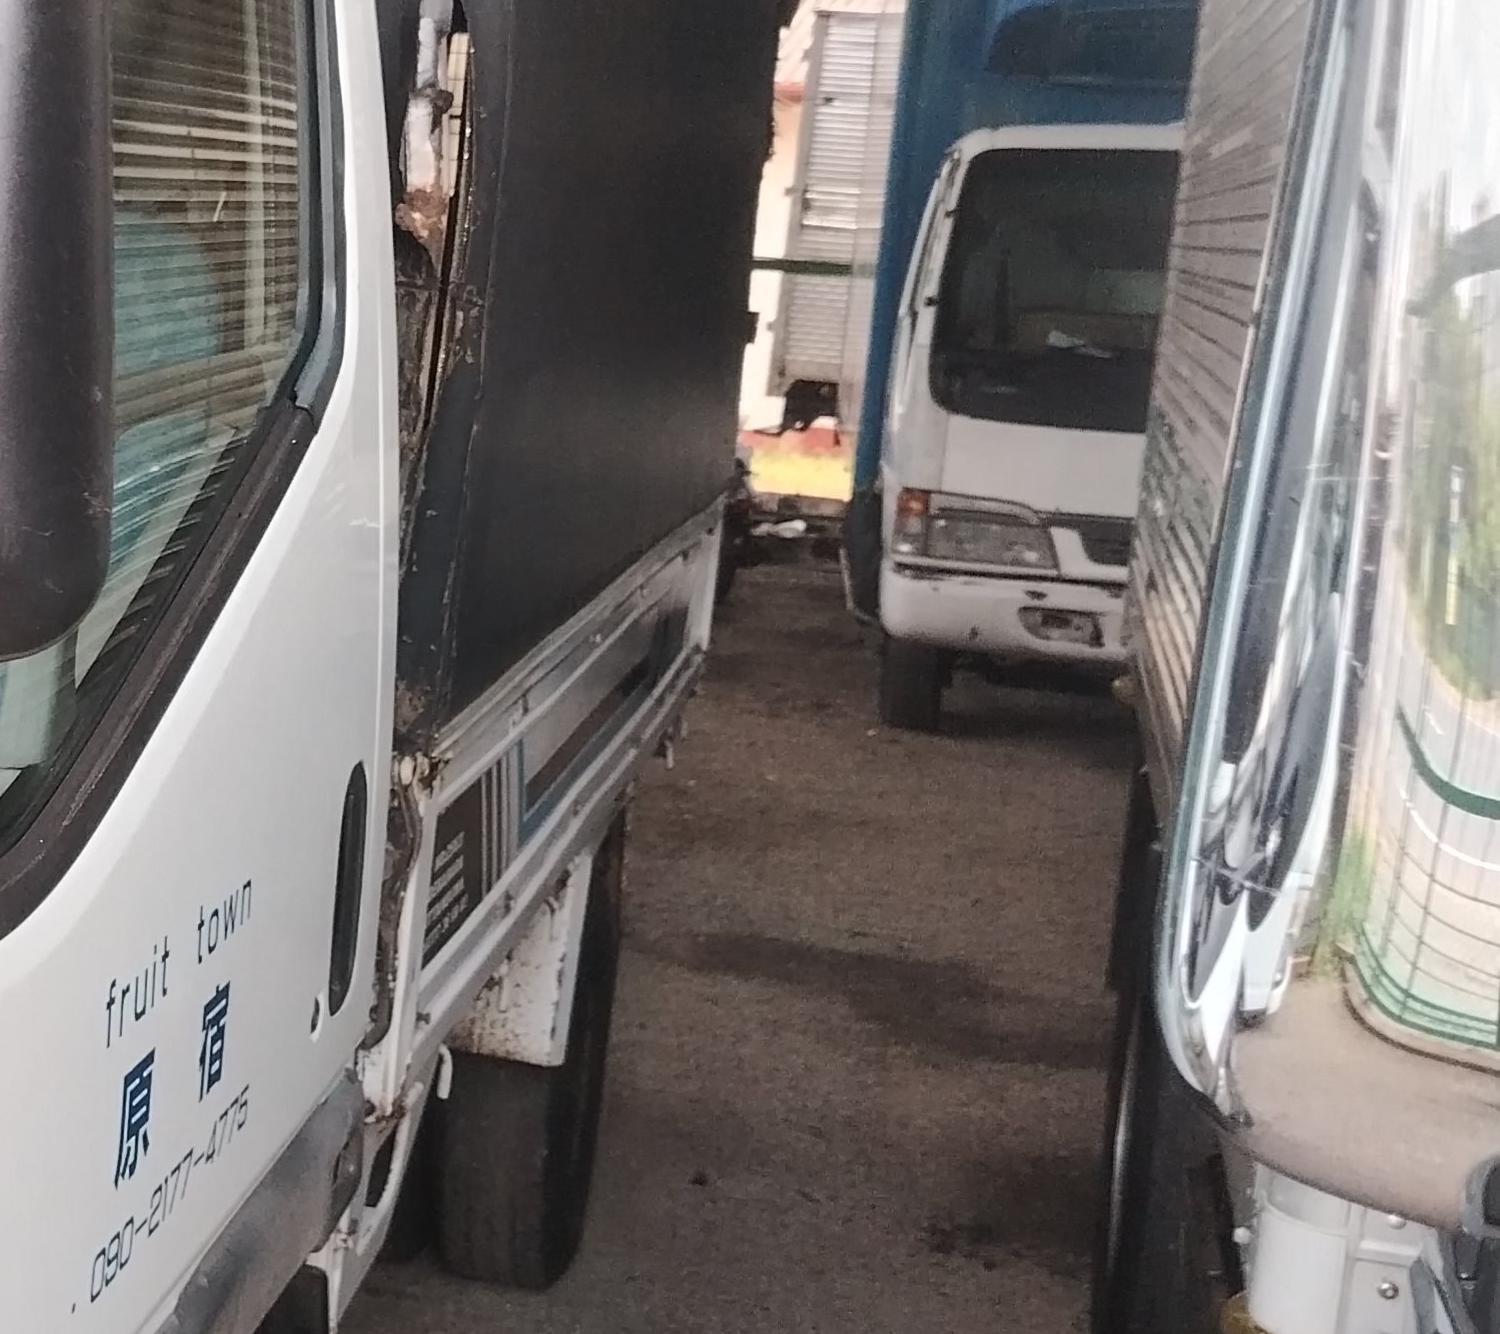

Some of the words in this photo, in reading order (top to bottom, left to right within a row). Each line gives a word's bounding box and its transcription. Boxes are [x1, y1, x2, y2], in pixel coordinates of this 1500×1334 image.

[106, 936, 171, 1048] fruit
[197, 878, 253, 965] town
[90, 1084, 250, 1304] 090-2177-4775
